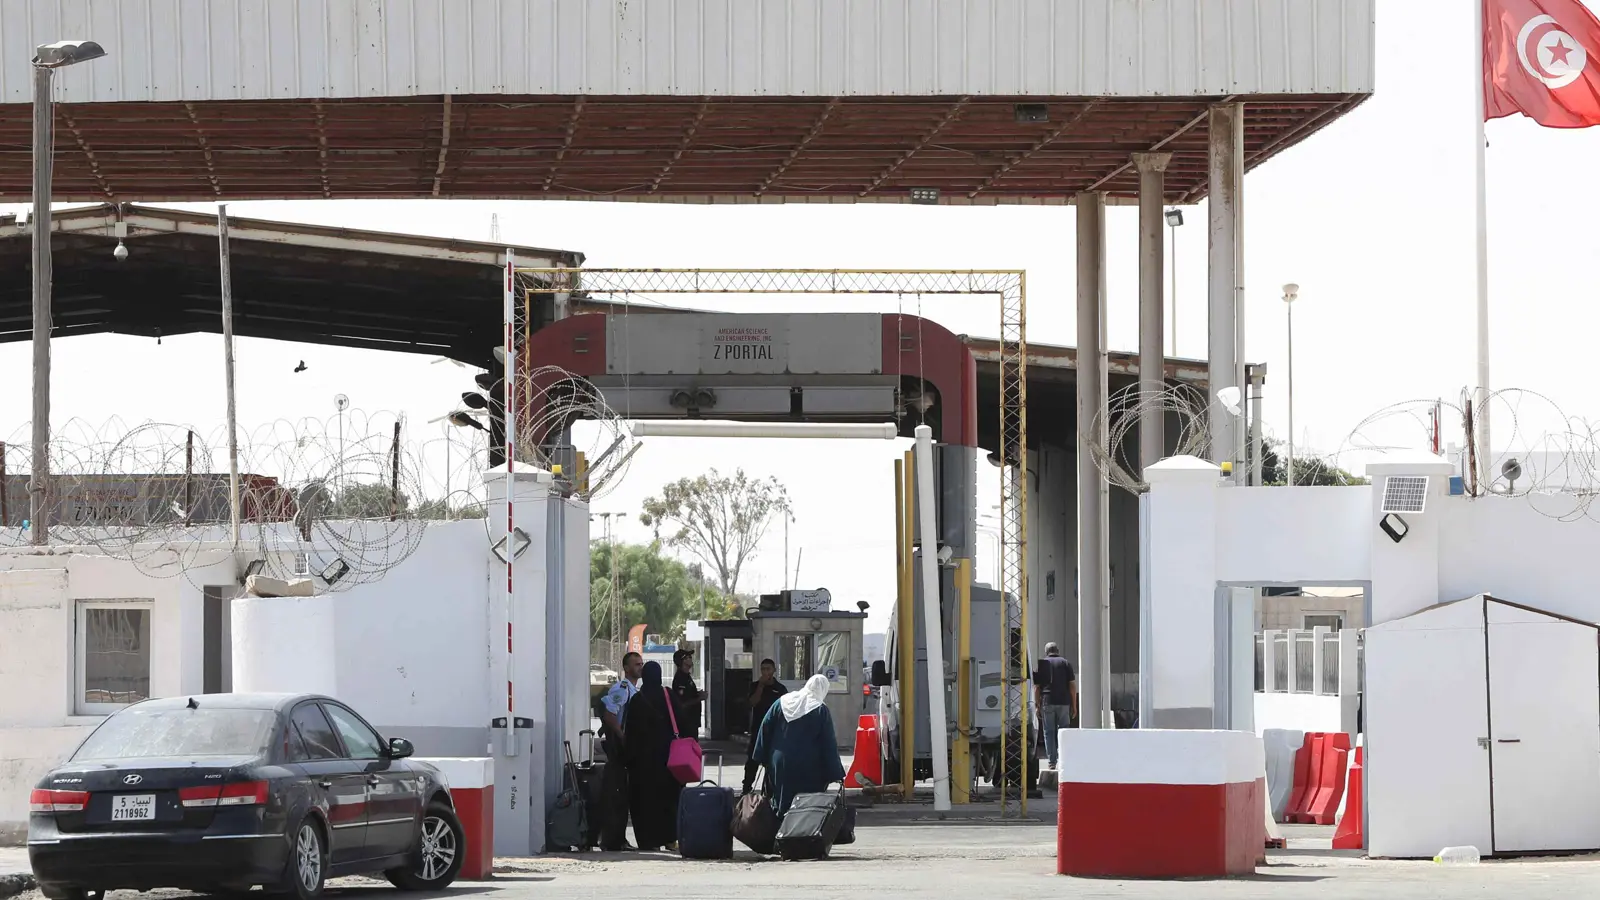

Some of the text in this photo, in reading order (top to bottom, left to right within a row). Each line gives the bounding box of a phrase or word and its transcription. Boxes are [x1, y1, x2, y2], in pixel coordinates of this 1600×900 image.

[713, 344, 774, 360] Z PORTAL
[121, 797, 127, 807] 5
[114, 808, 149, 818] 2118962
